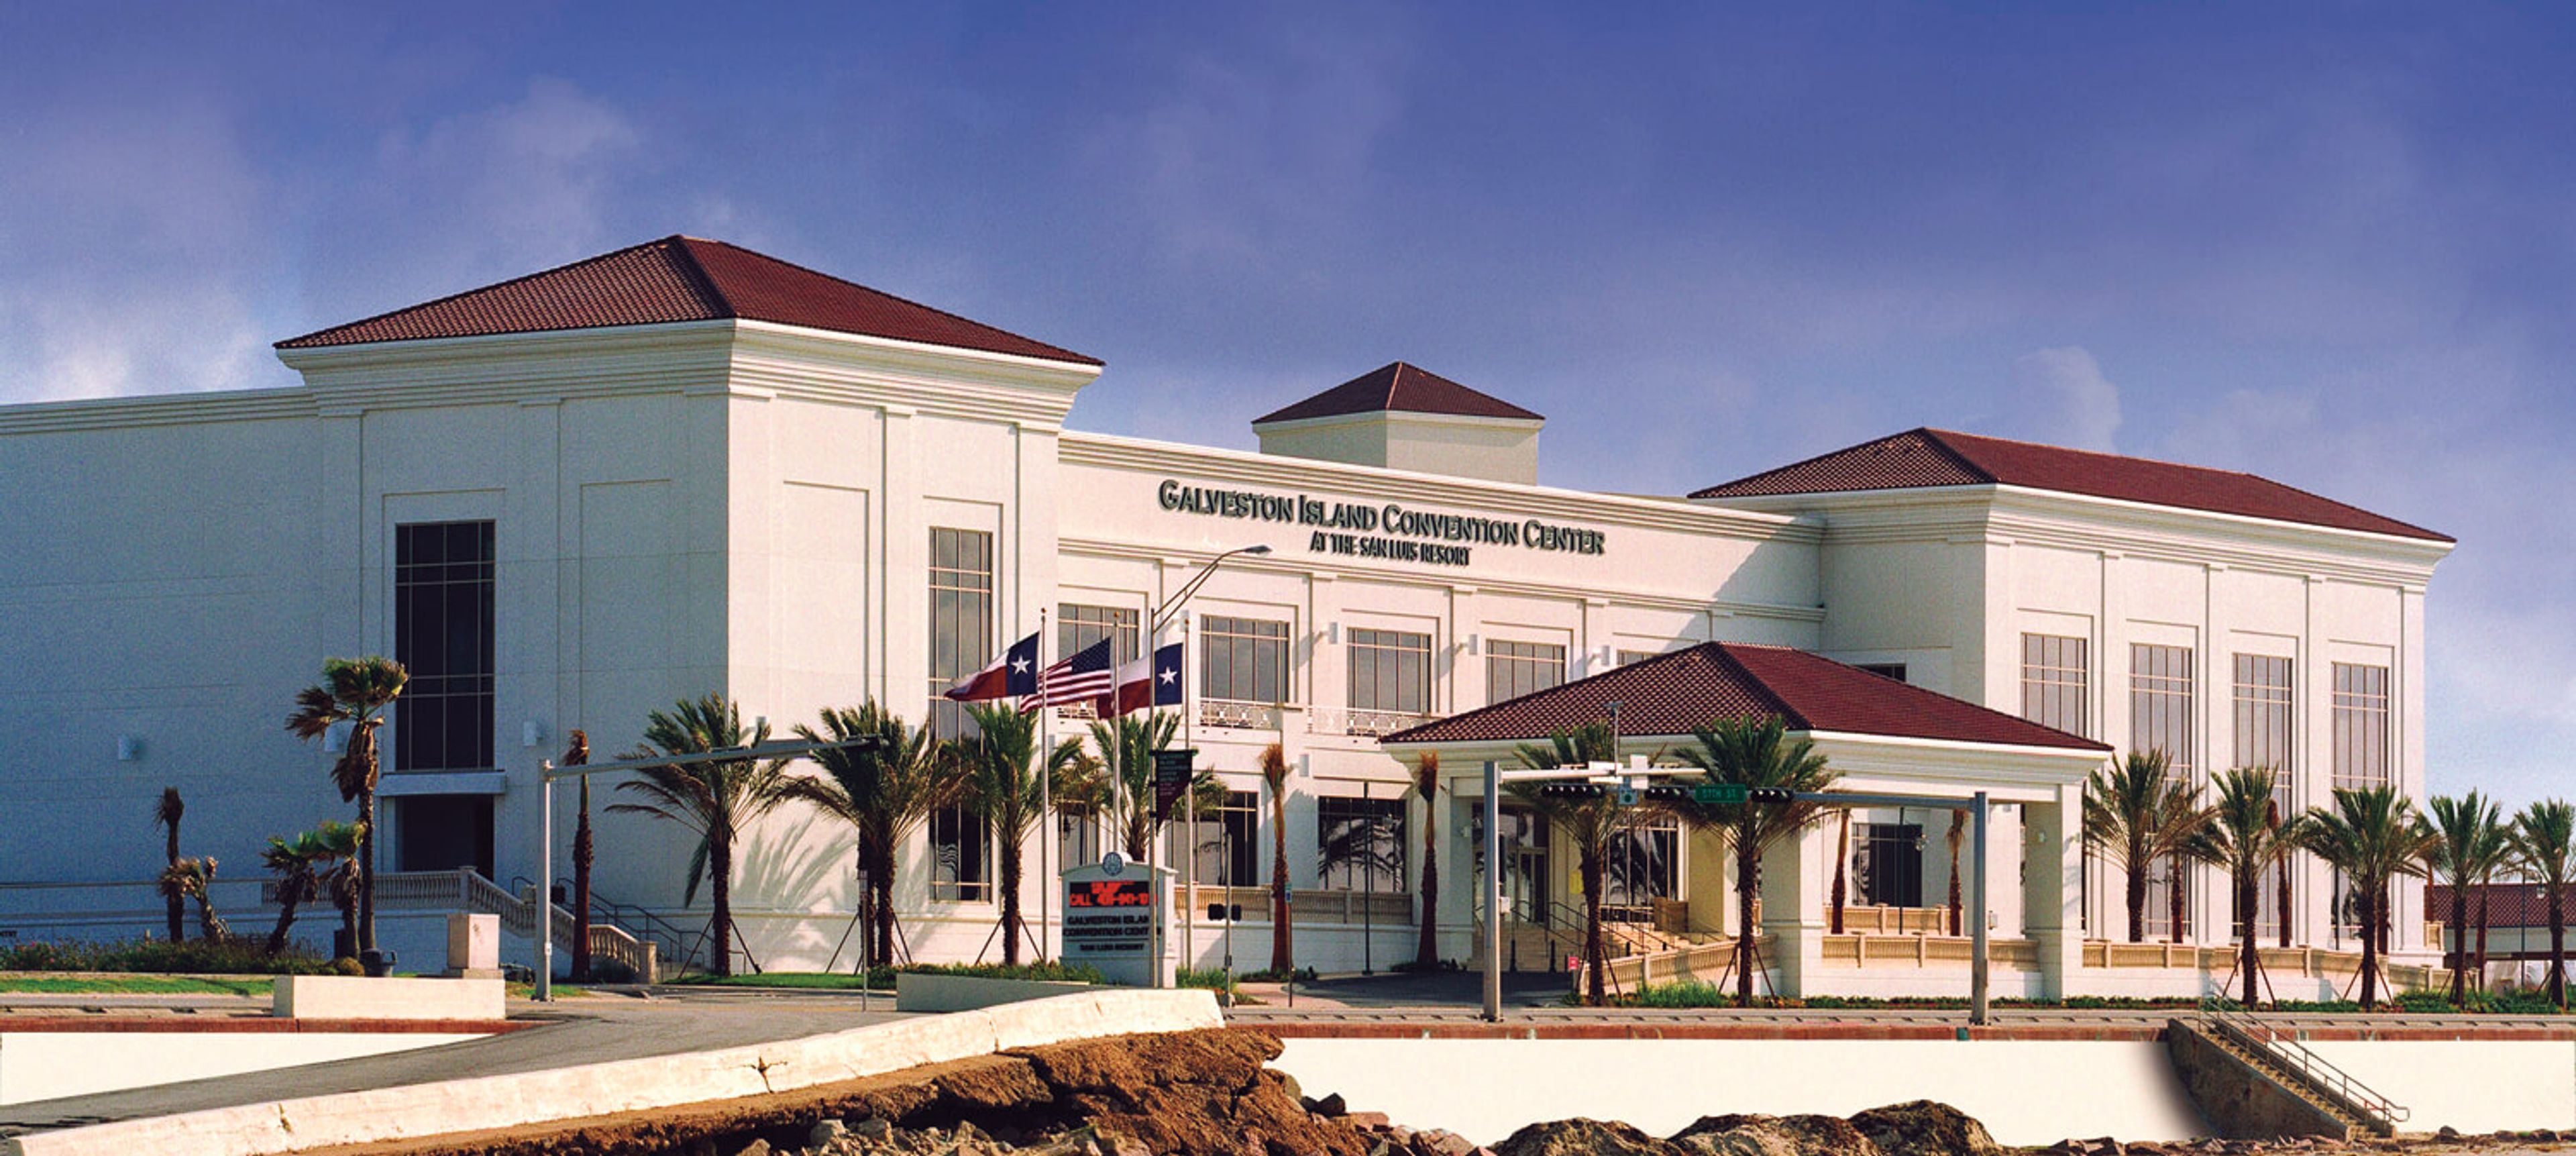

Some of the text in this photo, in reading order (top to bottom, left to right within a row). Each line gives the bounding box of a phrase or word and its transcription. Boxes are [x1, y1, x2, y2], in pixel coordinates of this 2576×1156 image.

[1159, 479, 1605, 556] GALVESTON ISLAND CONVENTION CENTER
[1309, 530, 1471, 566] AT THE SAN LUIS RESORT
[1123, 914, 1159, 925] ISLAN
[1124, 927, 1161, 936] CENTR
